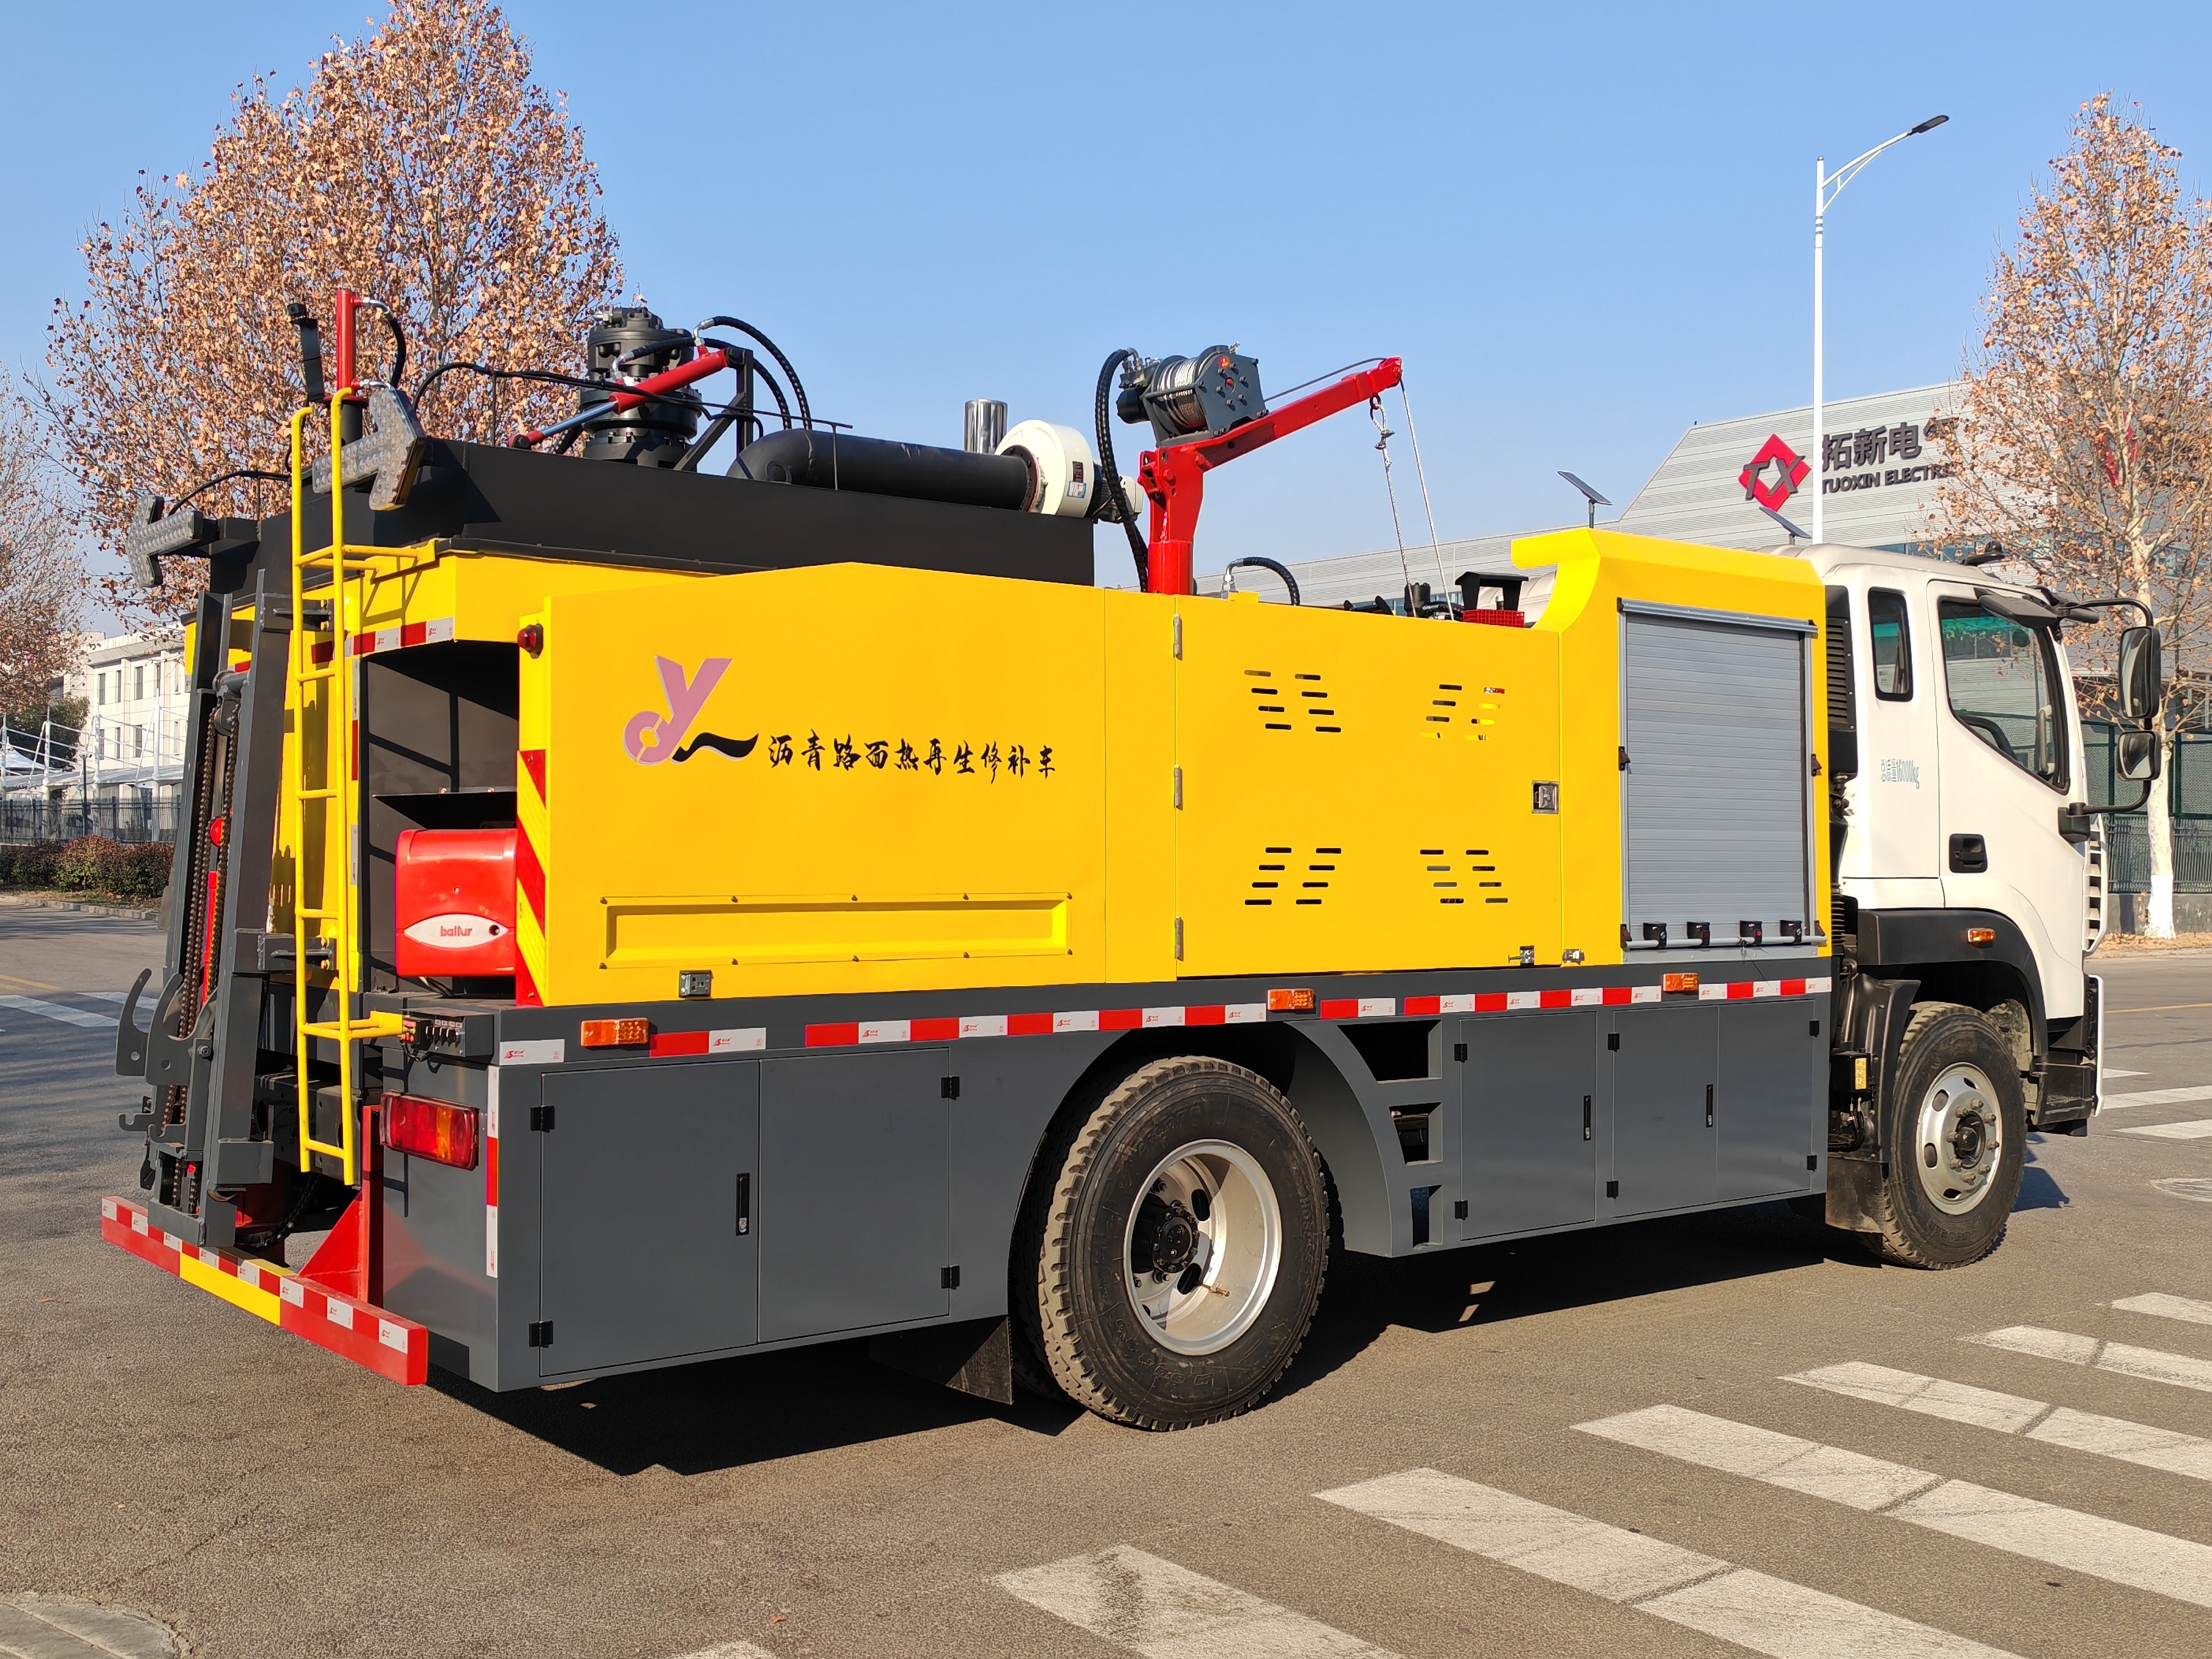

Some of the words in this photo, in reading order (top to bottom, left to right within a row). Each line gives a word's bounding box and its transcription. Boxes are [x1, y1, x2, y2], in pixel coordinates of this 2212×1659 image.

[1822, 472, 1881, 495] TUOXIN
[1885, 462, 1956, 487] ELECTR
[768, 728, 1055, 785] 沥青路面热再生修补车
[440, 925, 472, 937] baltur
